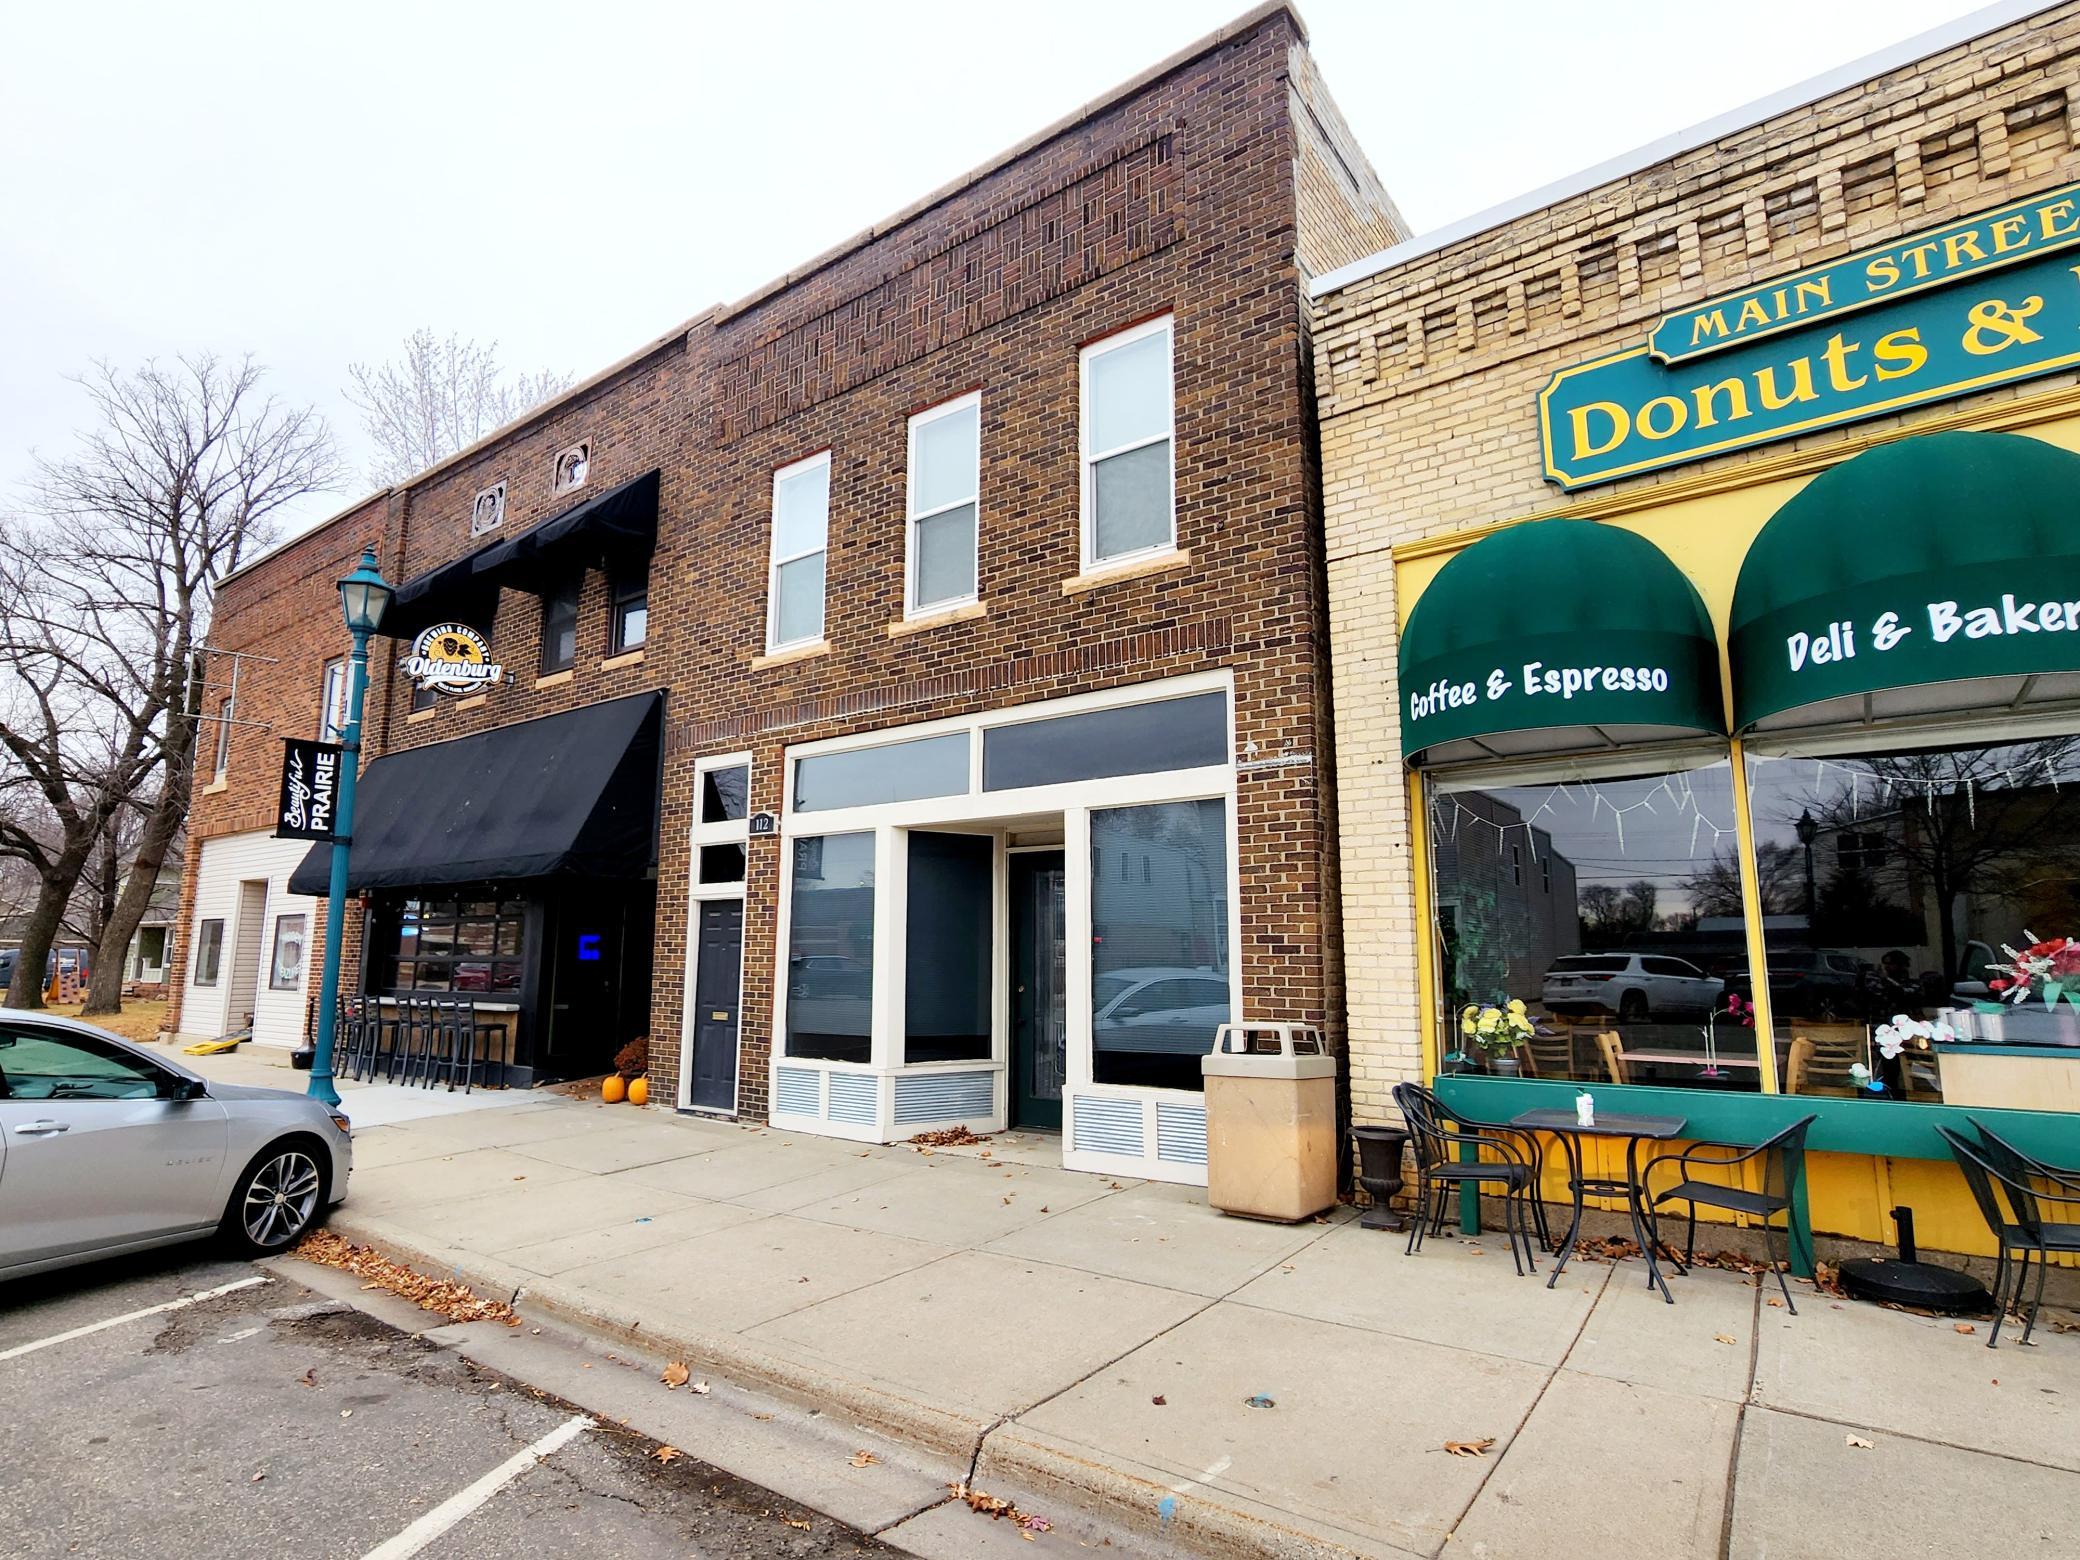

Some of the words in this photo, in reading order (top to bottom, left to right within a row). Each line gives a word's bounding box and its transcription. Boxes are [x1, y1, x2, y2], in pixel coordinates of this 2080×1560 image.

[1689, 275, 1834, 347] MAIN
[1865, 199, 2080, 293] STREE
[1566, 326, 1929, 462] Donuts
[1962, 294, 2044, 356] &
[407, 656, 502, 684] Oldenburg
[456, 626, 490, 657] COMPANY
[1787, 620, 1856, 671] Deli
[1872, 611, 1912, 650] &
[1927, 593, 2080, 643] Baker
[1410, 679, 1477, 721] Coffee
[1486, 668, 1512, 700] &
[1523, 661, 1669, 699] Espresso
[284, 748, 311, 831] Beautiful
[310, 753, 335, 831] PRAIRIE
[756, 818, 769, 831] 112
